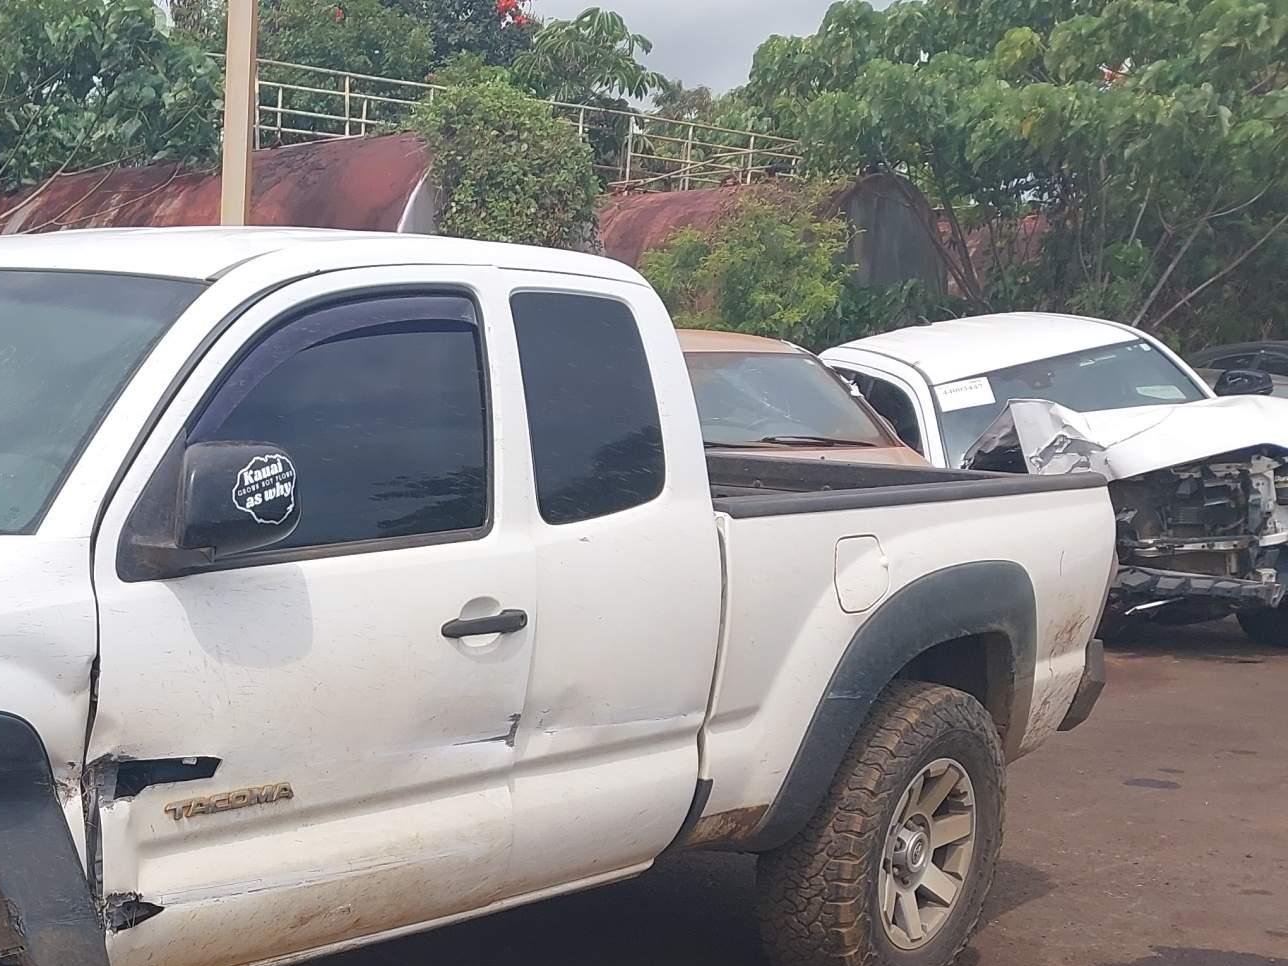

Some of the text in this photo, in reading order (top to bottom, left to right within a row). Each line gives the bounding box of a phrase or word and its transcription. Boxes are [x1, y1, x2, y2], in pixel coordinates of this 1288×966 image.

[243, 458, 283, 486] Kauai
[246, 481, 292, 508] as why
[164, 781, 295, 820] TACOMA
